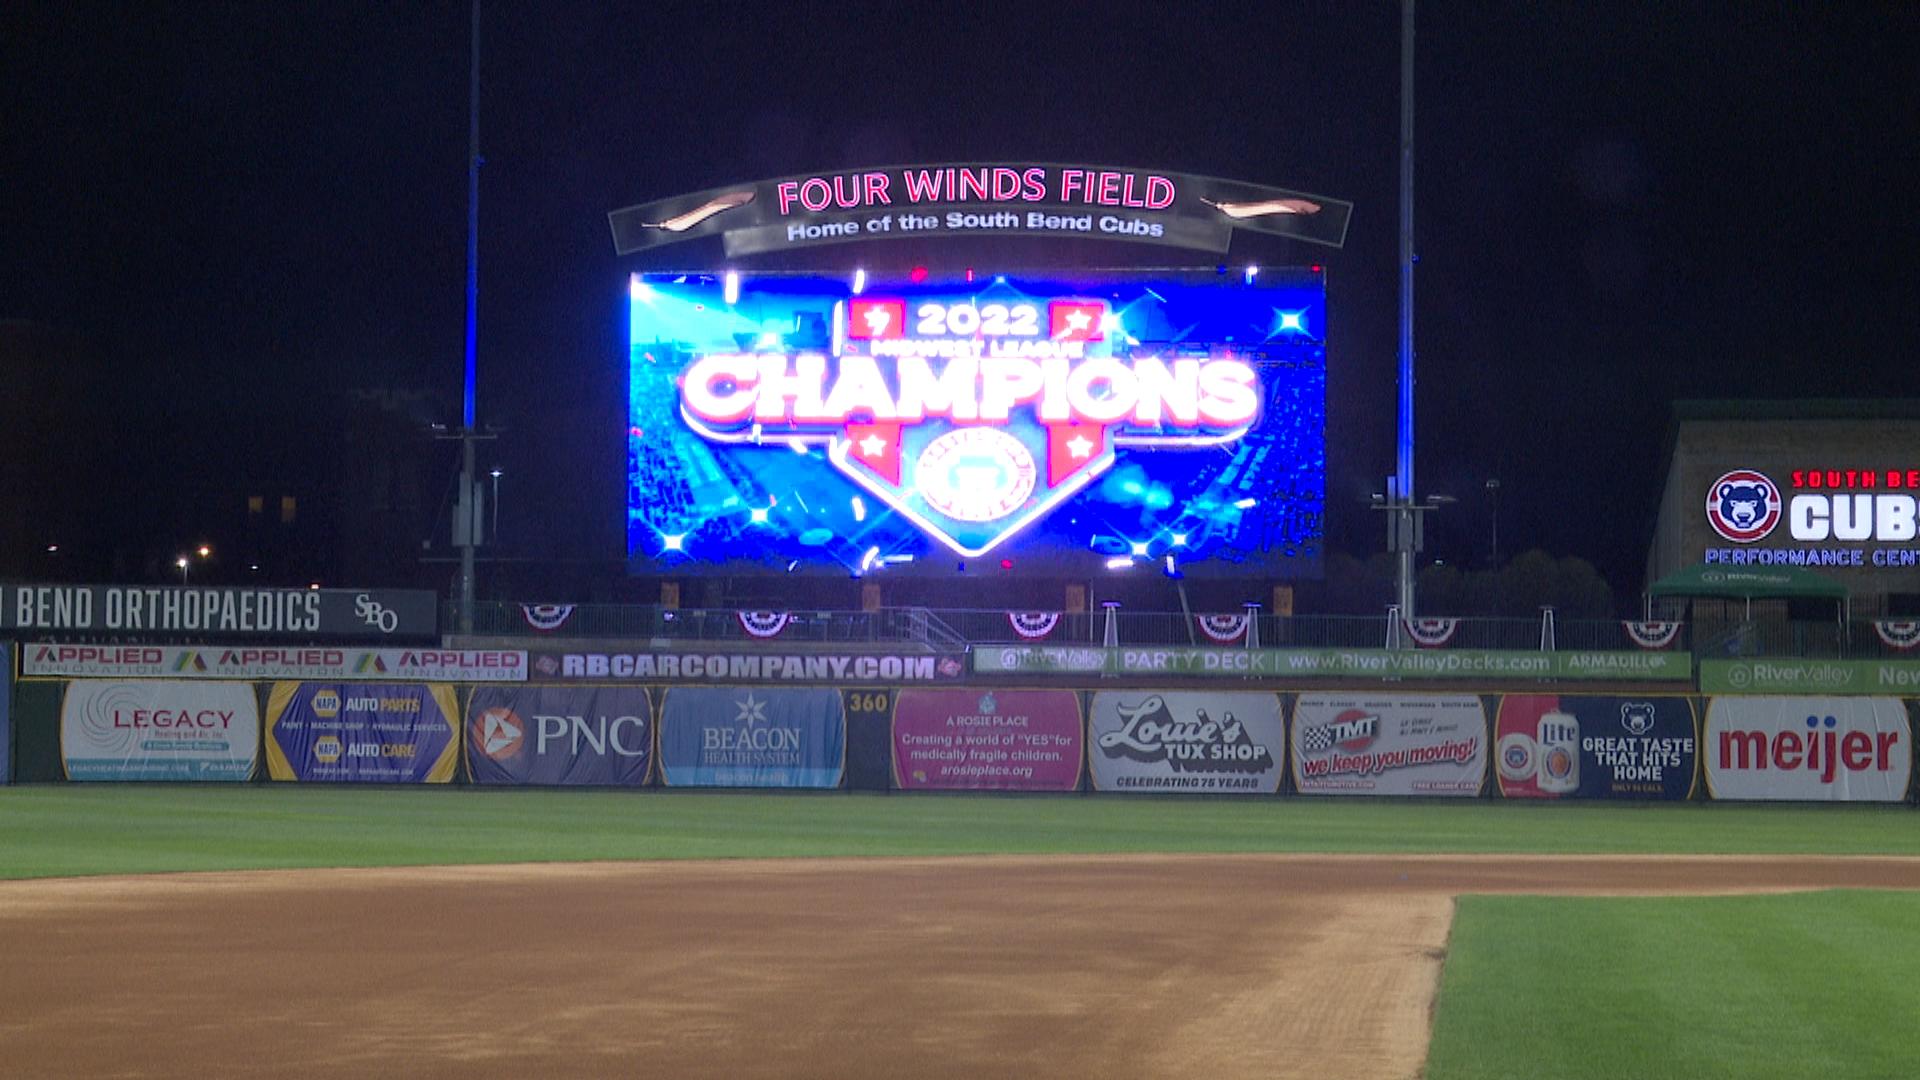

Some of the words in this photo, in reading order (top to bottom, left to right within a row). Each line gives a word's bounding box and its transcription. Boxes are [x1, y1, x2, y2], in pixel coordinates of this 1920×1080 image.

[777, 172, 891, 214] FOUR
[904, 167, 1047, 203] WINDS
[1060, 169, 1176, 209] FIELD
[787, 221, 860, 241] Home
[866, 217, 893, 234] of
[898, 214, 940, 231] the
[945, 212, 1020, 230] South
[1027, 212, 1091, 232] Bend
[1098, 214, 1165, 238] Cubs
[916, 303, 1040, 336] 2022
[684, 354, 1259, 424] CHAMPIONS
[1791, 470, 1876, 489] SOUTH
[1790, 493, 1920, 541] CUB
[1705, 548, 1864, 566] PERFORMANCE
[16, 587, 92, 628] BEND
[106, 588, 321, 632] ORTHOPAEDICS
[354, 594, 399, 633] SBO
[35, 646, 163, 664] APPLIED
[218, 650, 344, 666] APPLIED
[398, 651, 520, 668] APPLIED
[1124, 652, 1197, 669] PARTY
[1204, 653, 1264, 670] DECK
[1288, 653, 1550, 673] www.RiverValleyDecks.com
[32, 664, 163, 674] INNOVATION
[216, 665, 343, 676] INNOVATION
[397, 667, 521, 679] INNOVATION
[562, 654, 935, 680] RBCARCOMPANY.COM
[1753, 663, 1853, 684] RiverValley
[316, 697, 337, 709] NAPA
[346, 698, 379, 712] AUTO
[380, 698, 421, 713] PARTS
[850, 693, 887, 713] 360
[114, 710, 234, 729] LEGACY
[946, 717, 954, 726] A
[957, 717, 991, 726] ROSIE
[992, 717, 1028, 727] PLACE
[1100, 695, 1241, 752] Louie's
[533, 715, 644, 756] PNC
[704, 728, 801, 750] BEACON
[1331, 716, 1378, 743] TMT
[1543, 722, 1576, 746] Lite
[902, 733, 952, 746] Creating
[955, 736, 963, 745] a
[964, 734, 999, 745] world
[1002, 734, 1014, 745] of
[1055, 735, 1072, 746] for
[1583, 738, 1637, 752] GREAT
[1641, 738, 1693, 753] TASTE
[1719, 715, 1899, 783] meijer
[318, 743, 338, 755] NAPA
[347, 744, 380, 757] AUTO
[381, 744, 416, 758] CARE
[704, 752, 750, 764] HEALTH
[753, 752, 800, 765] SYSTEM
[911, 749, 968, 762] medically
[970, 749, 1008, 762] fragile
[1011, 750, 1063, 761] children.
[1165, 744, 1205, 760] TUX
[1211, 744, 1266, 760] SHOP
[1303, 759, 1329, 775] we
[1332, 754, 1373, 774] keep
[1374, 750, 1405, 771] you
[1410, 738, 1477, 763] moving!
[1595, 752, 1639, 766] THAT
[1642, 752, 1681, 767] HITS
[941, 765, 1033, 777] arosieplace.org
[1614, 766, 1662, 781] HOME
[1116, 776, 1200, 788] CELEBRATING
[1219, 778, 1259, 789] YEARS
